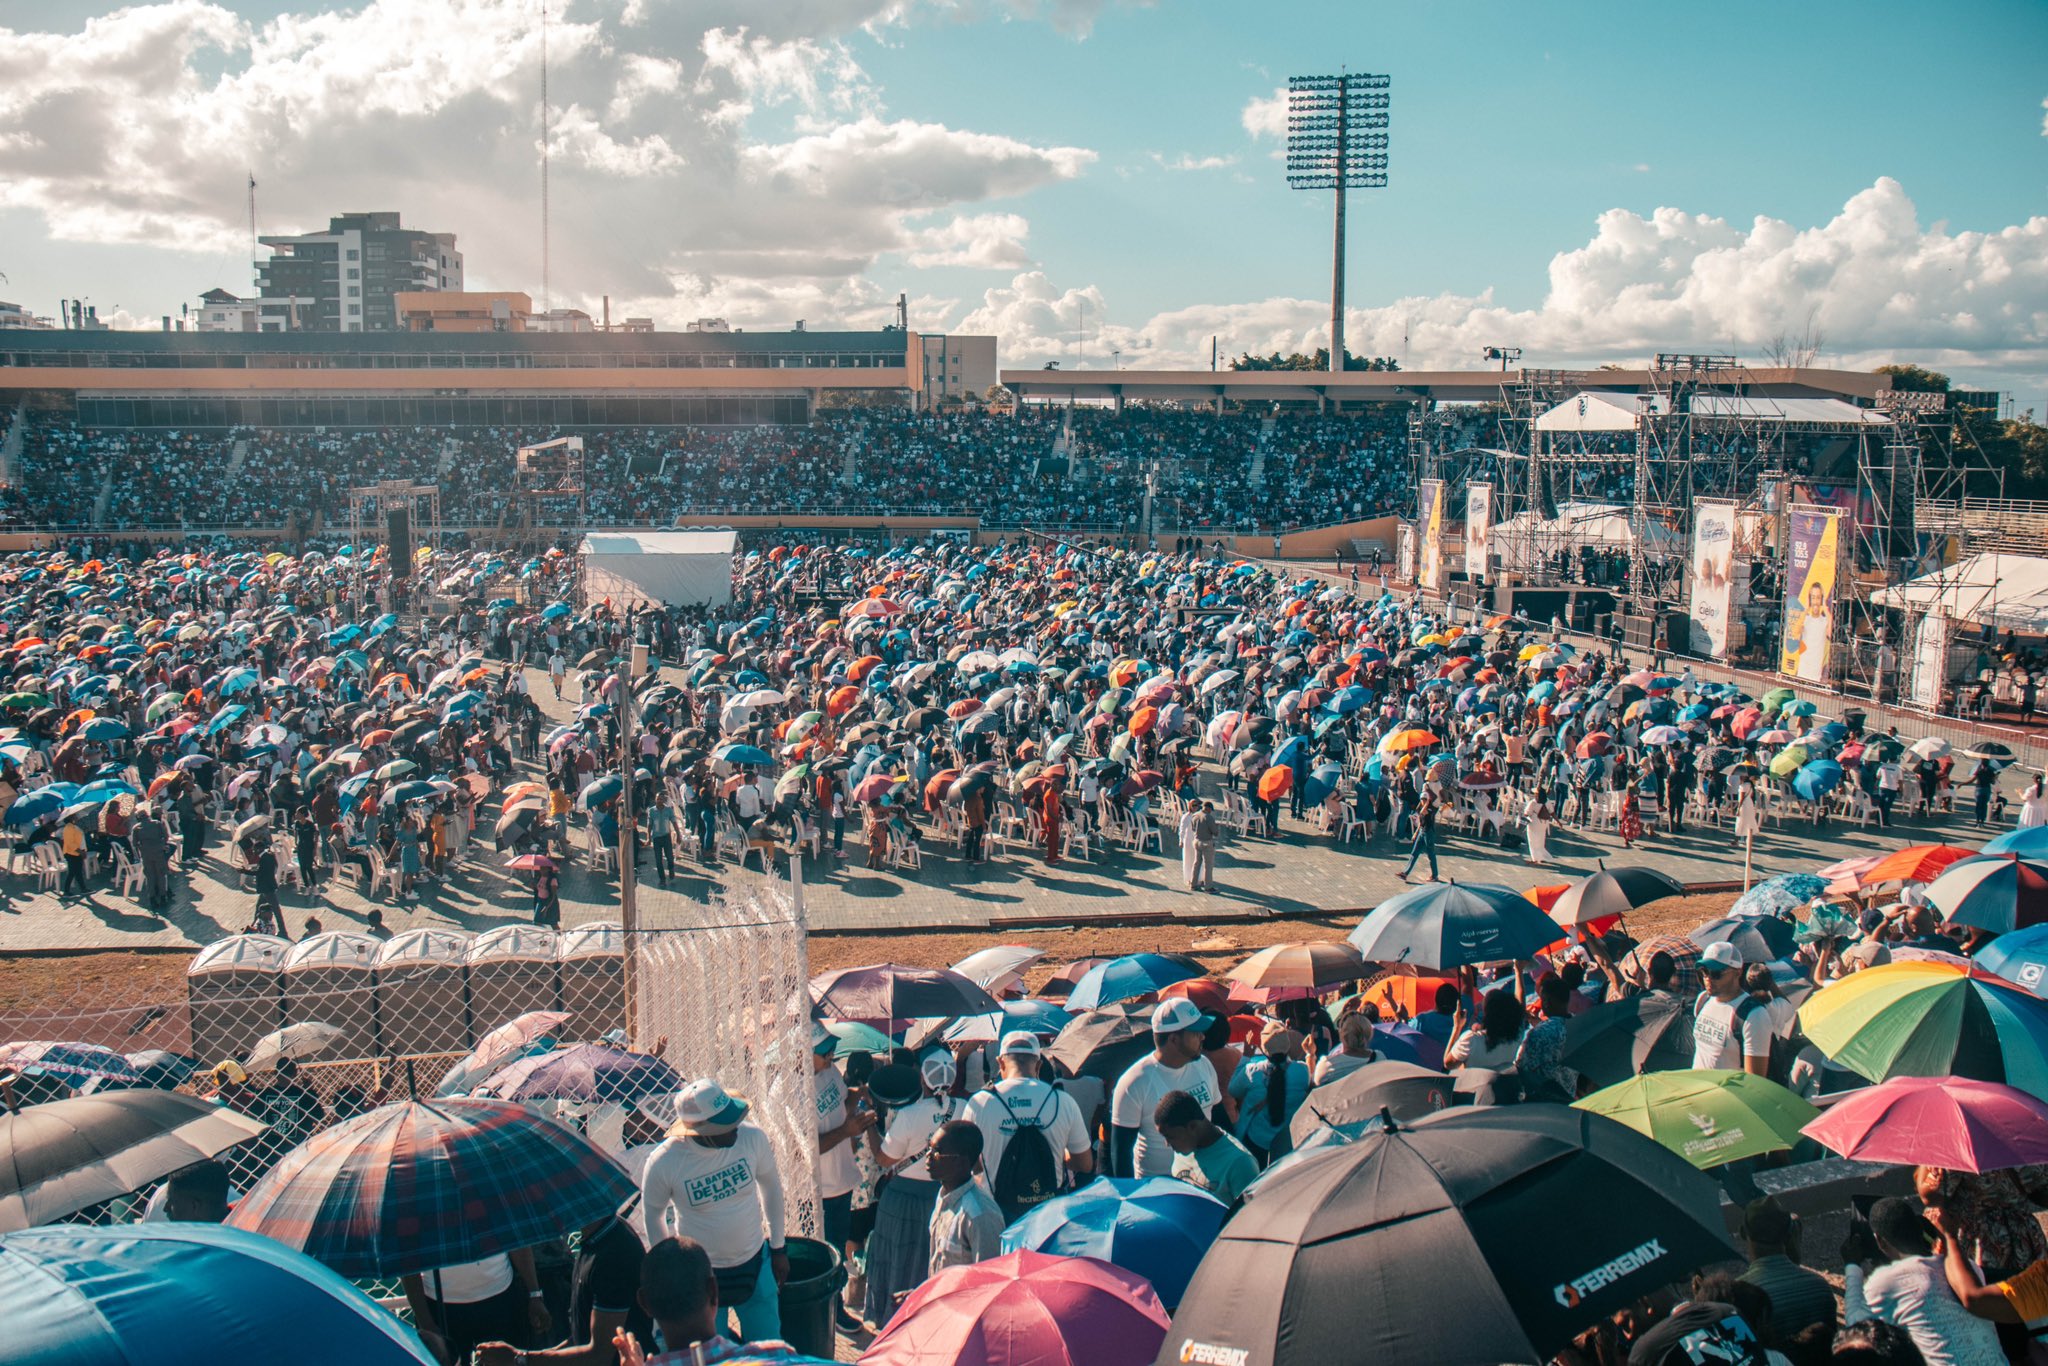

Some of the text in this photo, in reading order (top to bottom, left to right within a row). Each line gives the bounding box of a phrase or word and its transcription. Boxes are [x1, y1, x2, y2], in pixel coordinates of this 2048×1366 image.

[1794, 559, 1807, 568] 1200
[691, 1163, 744, 1190] LA BATALLA
[693, 1169, 749, 1201] DE LA FE
[713, 1187, 737, 1202] 2023
[1570, 1238, 1668, 1299] FERREMIX
[1190, 1342, 1249, 1366] FERREMIX
